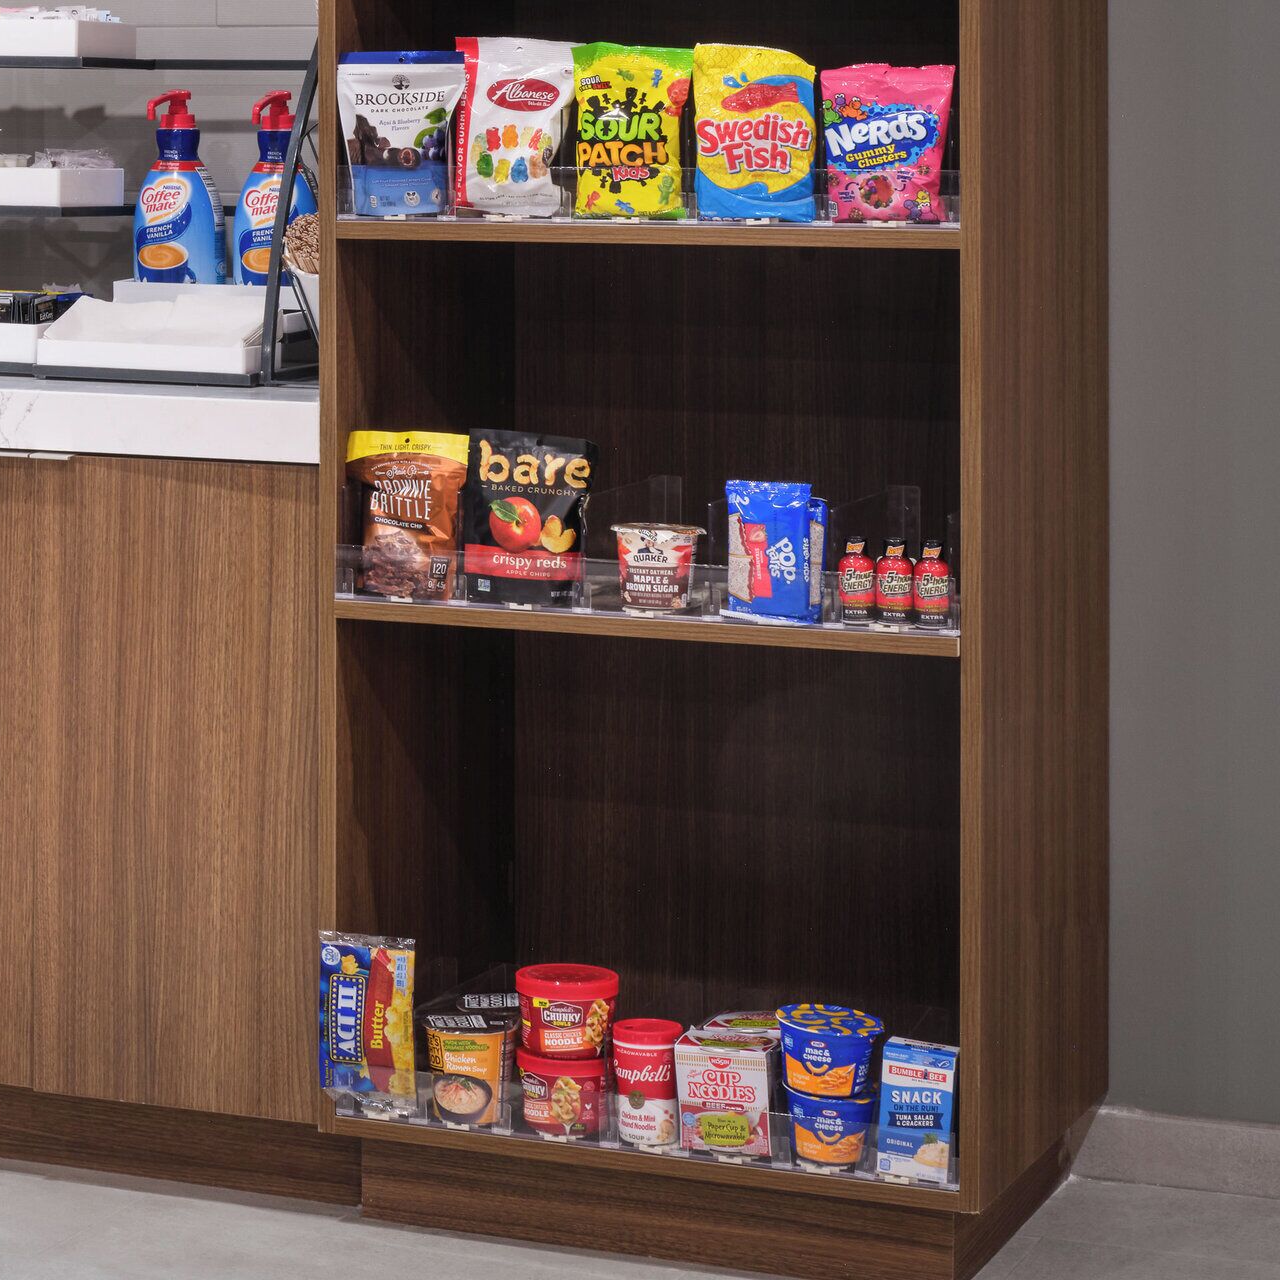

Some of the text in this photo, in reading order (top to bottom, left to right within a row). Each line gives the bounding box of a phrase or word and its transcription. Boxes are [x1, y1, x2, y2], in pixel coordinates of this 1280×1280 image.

[580, 76, 600, 86] SOUR
[355, 90, 445, 106] BROOKSIDE
[392, 105, 429, 113] CHOCOLATE
[580, 111, 663, 141] SOUR
[696, 114, 812, 154] Swedish
[578, 141, 668, 167] PATCH
[722, 143, 791, 173] Fish
[845, 143, 896, 162] Gummy
[858, 150, 908, 168] Clusters
[614, 166, 649, 181] Kids
[142, 187, 180, 205] Coffee
[146, 201, 176, 213] mate
[146, 224, 172, 233] FRENCH
[146, 229, 173, 239] VANILLA
[478, 439, 591, 488] bare
[491, 484, 578, 496] BAKED CRUNCHY
[371, 492, 432, 520] BRITTLE
[492, 553, 567, 570] crispy reds
[633, 553, 669, 564] QUAKER
[432, 563, 447, 574] 120
[633, 575, 661, 584] MAPLE
[842, 578, 874, 591] ENERGY
[625, 583, 679, 594] BROWN SUGAR
[882, 581, 912, 593] ENERGY
[919, 583, 949, 596] ENERGY
[543, 1011, 581, 1023] CHUNKY
[370, 1000, 385, 1049] Butter
[544, 1037, 583, 1045] NOODLE
[445, 1052, 476, 1063] Chicken
[702, 1070, 741, 1085] CUP
[889, 1065, 947, 1082] BUMBLE BEE
[688, 1082, 756, 1102] NOODLES
[891, 1090, 942, 1105] SNACK
[895, 1113, 934, 1123] TUNA SALAD
[886, 1138, 914, 1148] ORIGINAL
